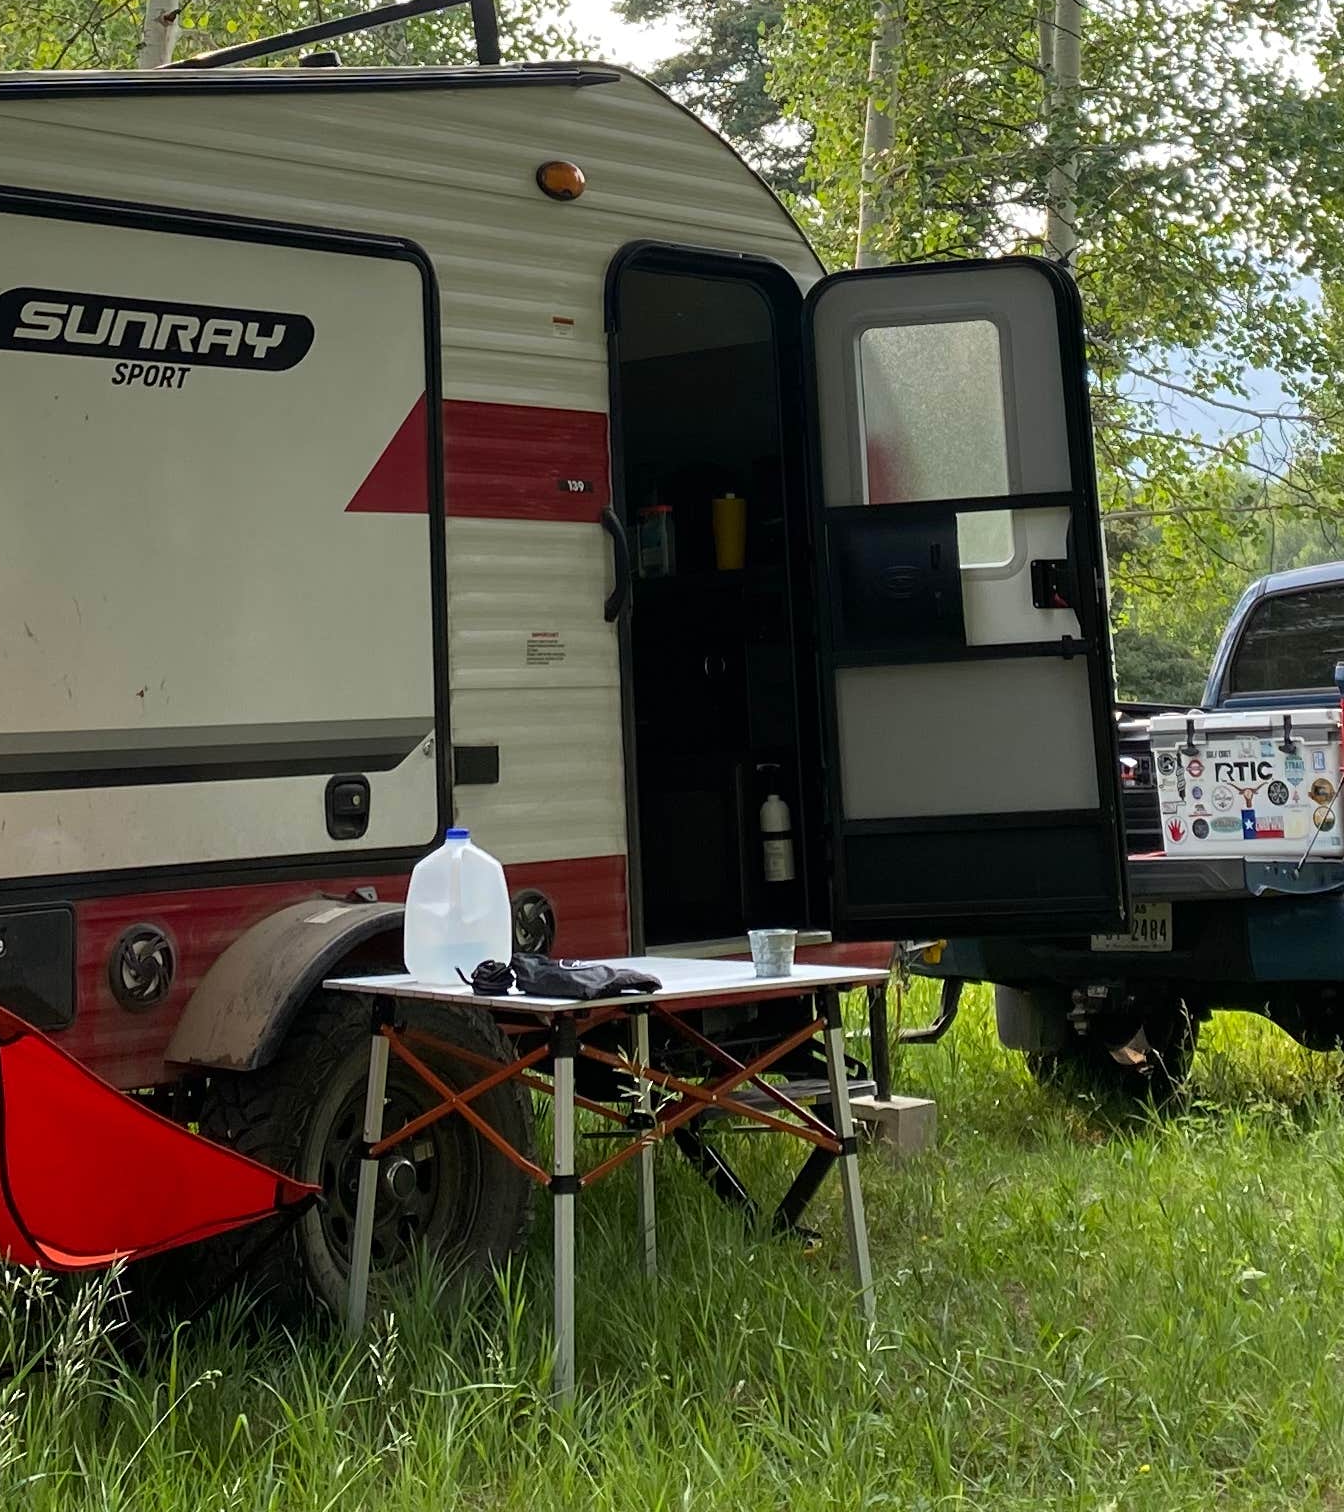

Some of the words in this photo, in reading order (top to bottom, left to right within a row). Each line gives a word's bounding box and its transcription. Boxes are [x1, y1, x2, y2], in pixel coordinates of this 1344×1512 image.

[13, 301, 286, 358] SUNRAY
[111, 362, 191, 389] SPORT
[567, 479, 585, 492] 139
[1214, 760, 1273, 783] RTIC
